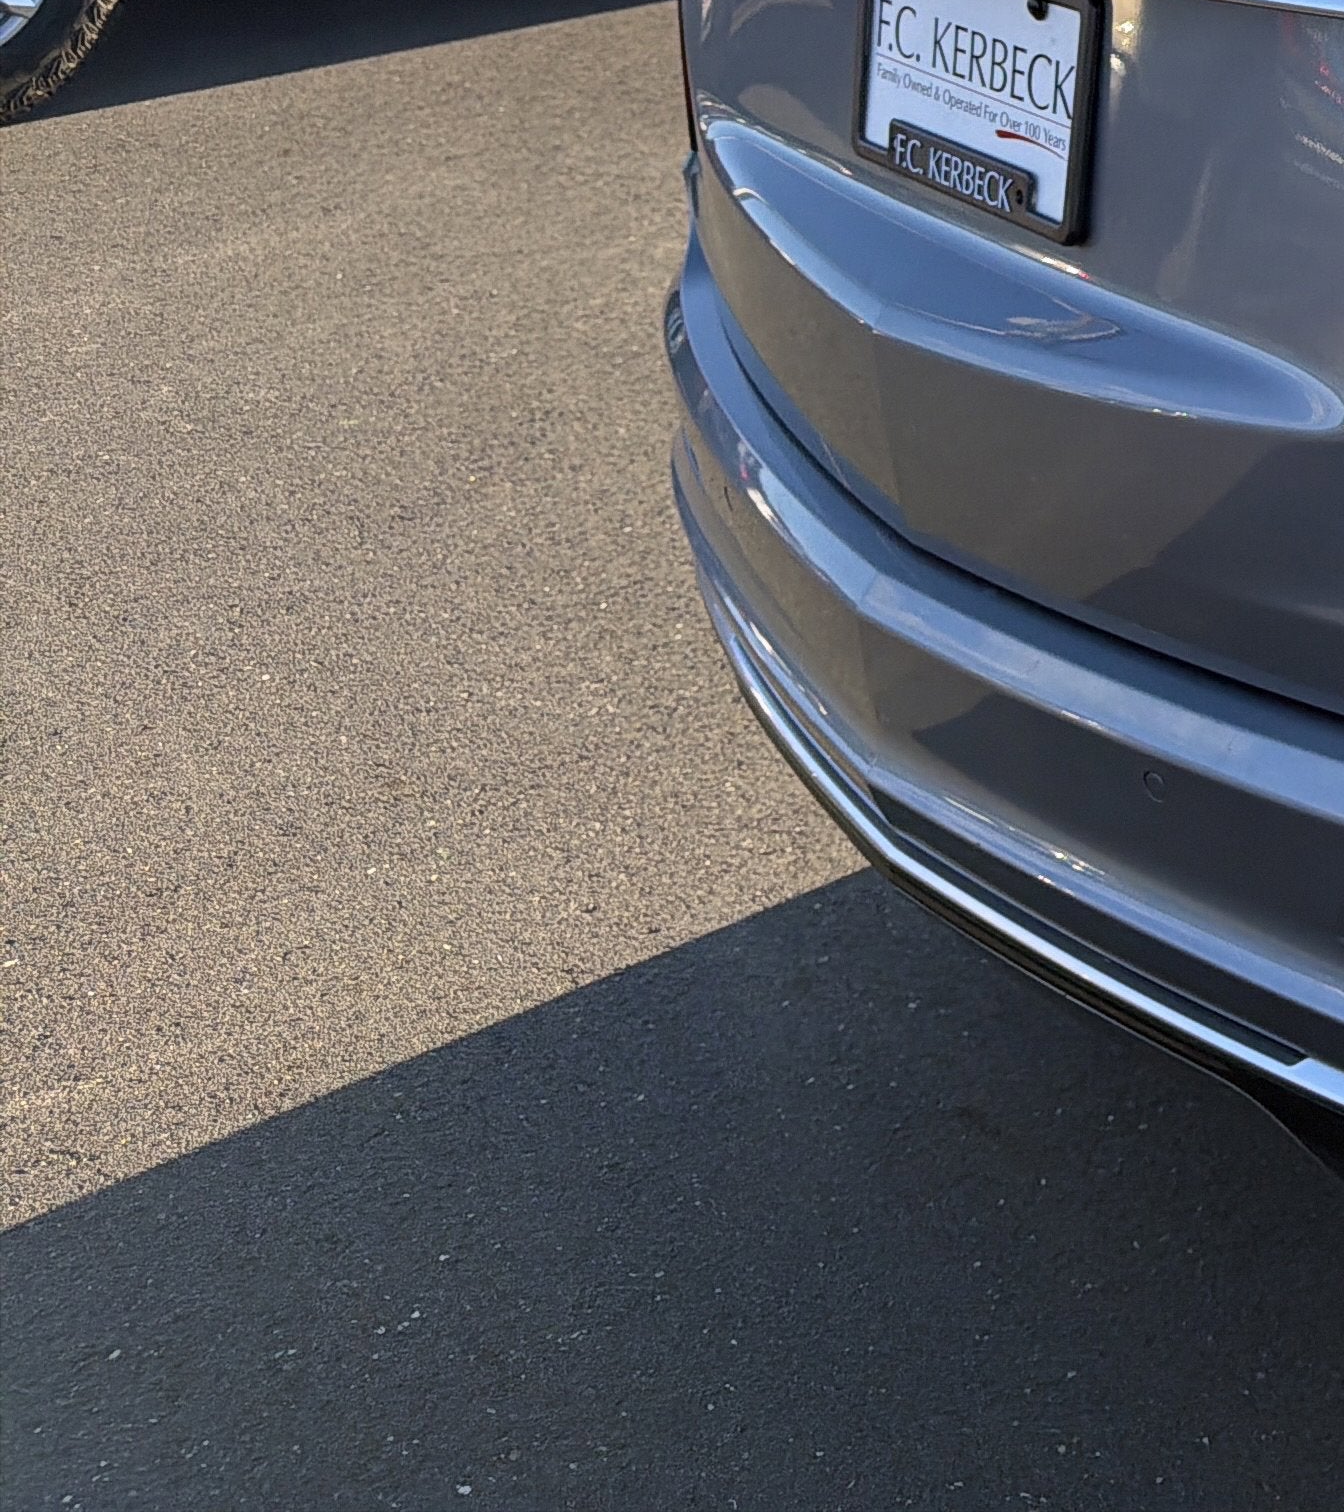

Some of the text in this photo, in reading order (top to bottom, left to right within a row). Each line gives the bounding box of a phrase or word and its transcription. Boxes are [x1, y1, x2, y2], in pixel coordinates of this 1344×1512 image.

[876, 62, 1067, 152] Family Owned & Operated For Over 100 Years
[931, 17, 1076, 120] KERBECK
[893, 133, 1013, 214] F.C. KERBECK
